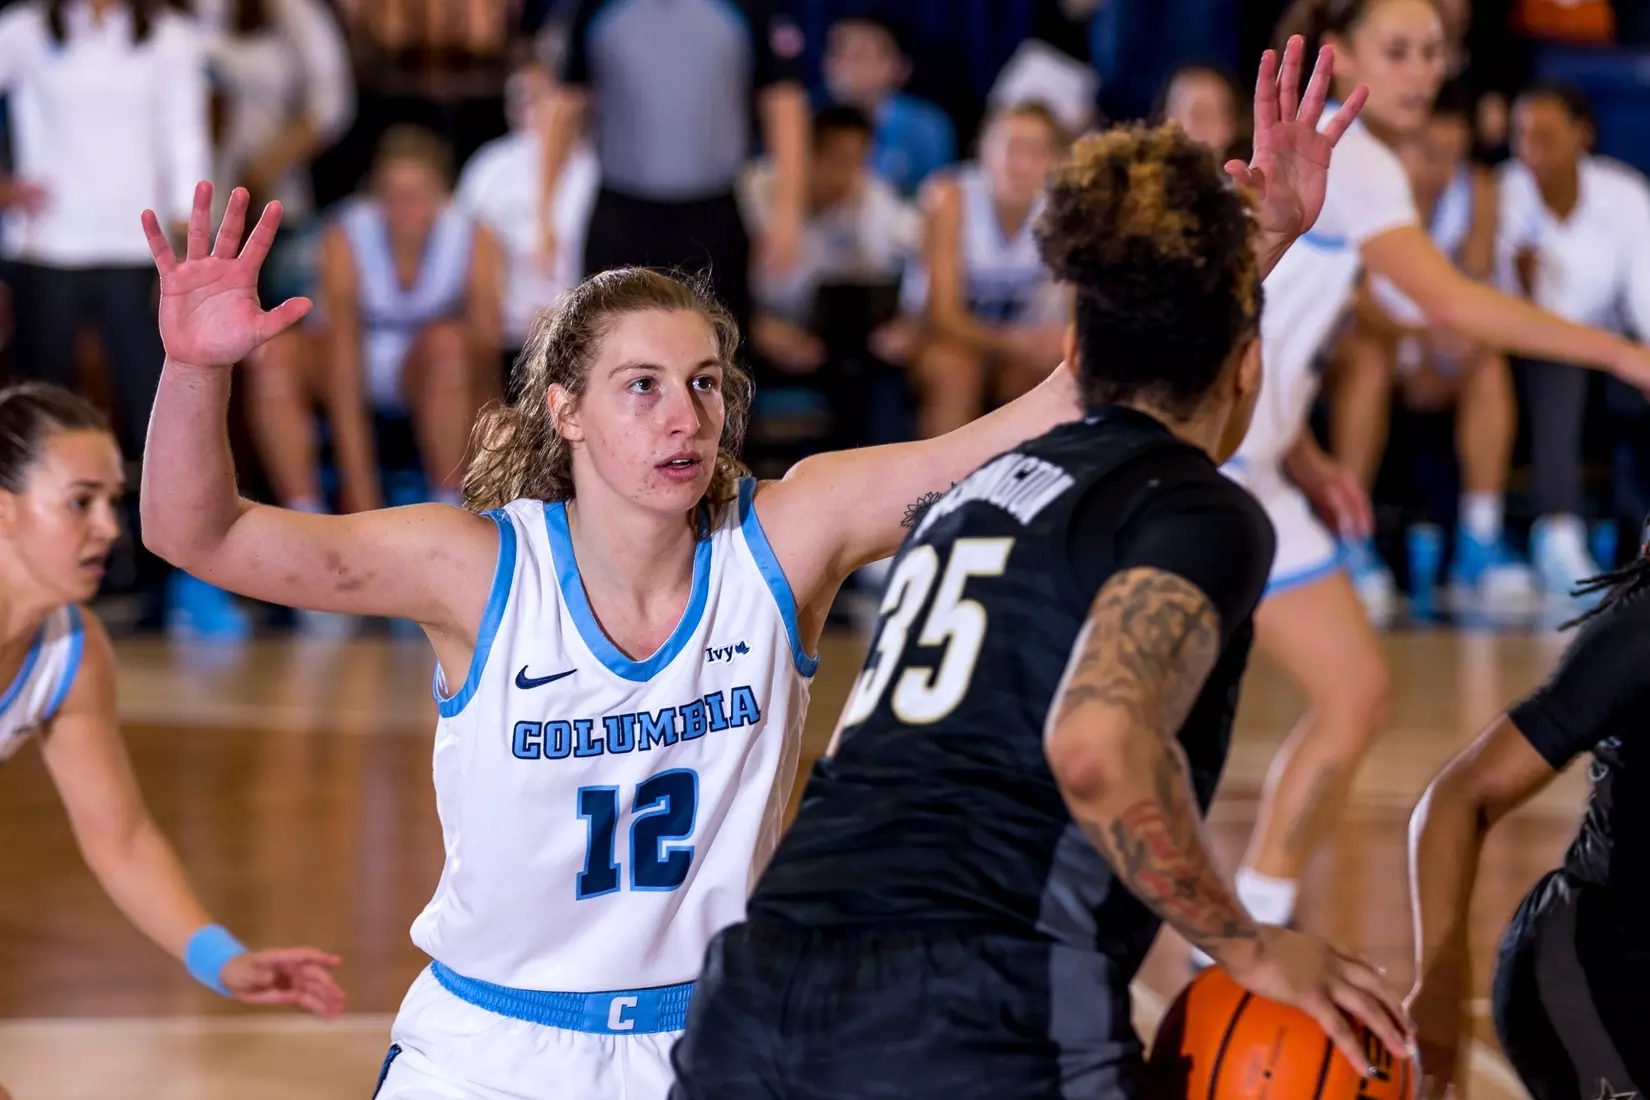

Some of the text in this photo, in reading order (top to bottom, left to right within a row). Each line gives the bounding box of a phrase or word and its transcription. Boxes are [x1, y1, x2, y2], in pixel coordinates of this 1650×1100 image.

[707, 645, 734, 662] Ivy
[843, 537, 1016, 725] 35
[512, 685, 761, 760] COLUMBIA
[576, 767, 699, 901] 12
[607, 996, 638, 1030] C
